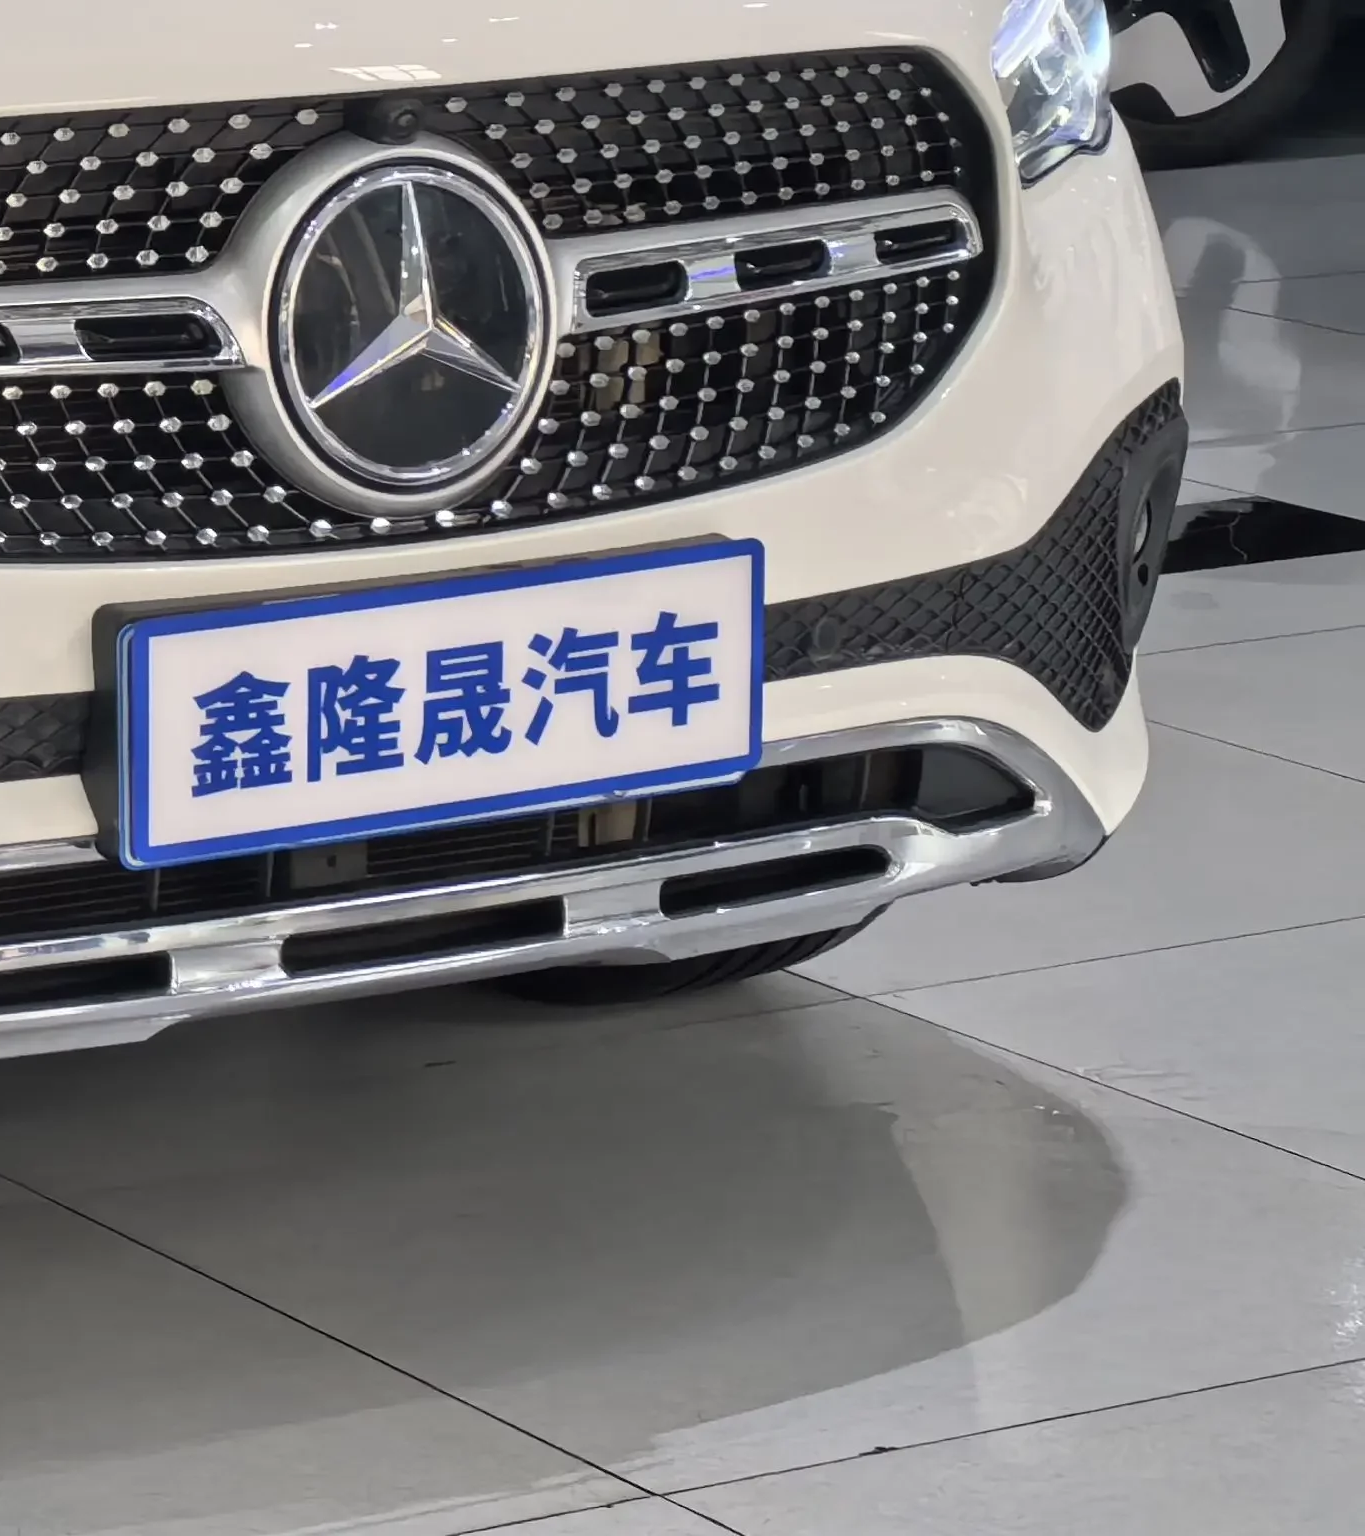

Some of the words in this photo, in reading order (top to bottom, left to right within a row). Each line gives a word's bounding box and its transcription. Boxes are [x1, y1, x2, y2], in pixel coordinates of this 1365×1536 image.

[191, 611, 721, 798] 鑫隆晟汽车
